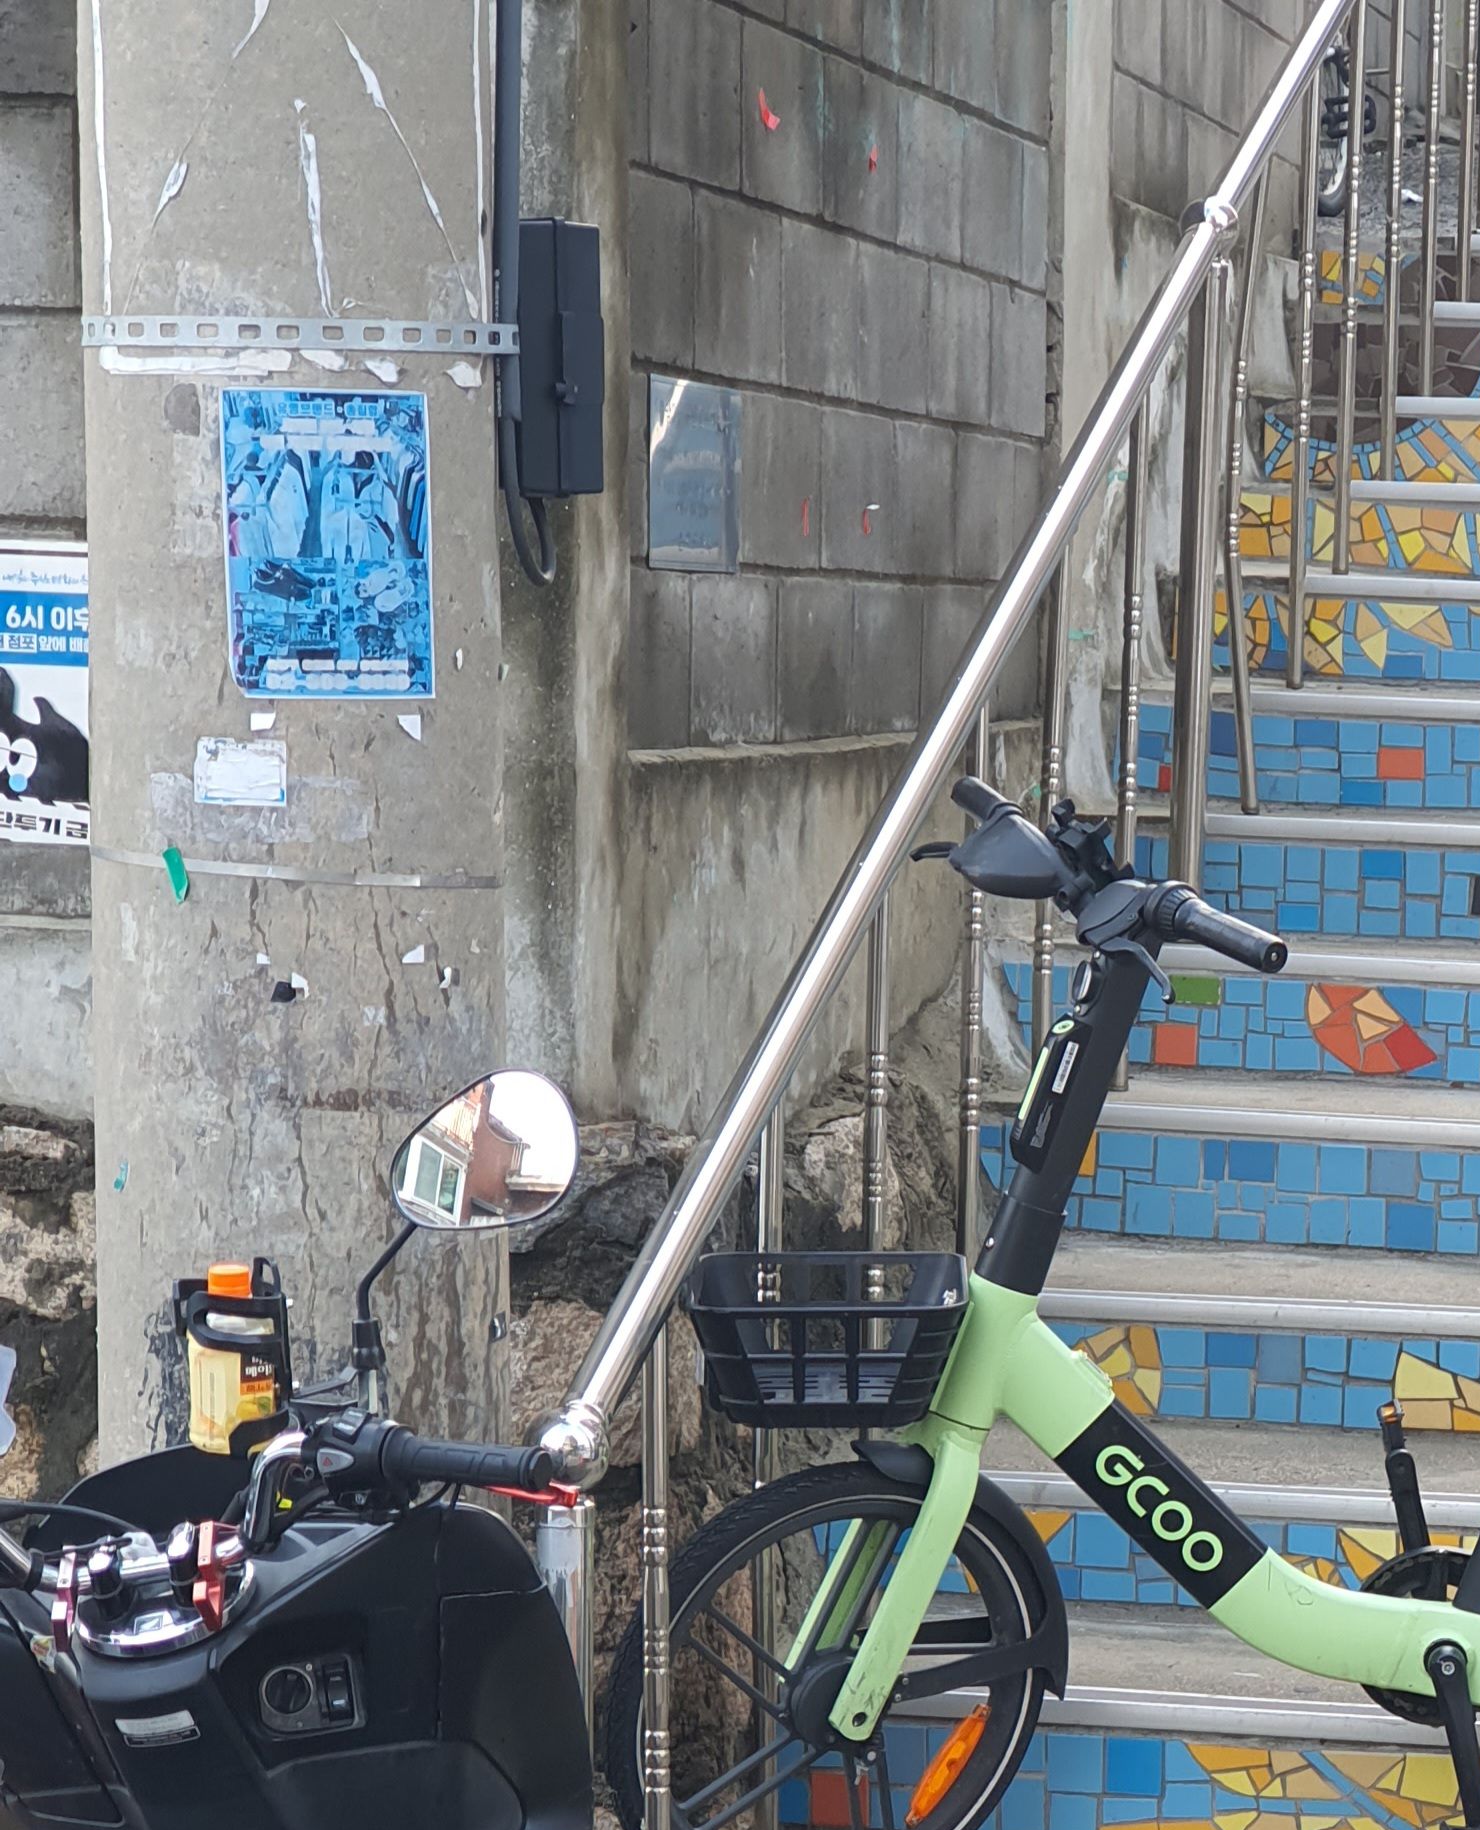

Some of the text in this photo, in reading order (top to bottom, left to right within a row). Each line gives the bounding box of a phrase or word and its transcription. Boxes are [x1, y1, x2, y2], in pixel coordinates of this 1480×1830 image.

[5, 604, 44, 630] 6시
[8, 634, 34, 650] 점포
[38, 635, 67, 652] 앞에
[1095, 1444, 1223, 1572] GCOO
